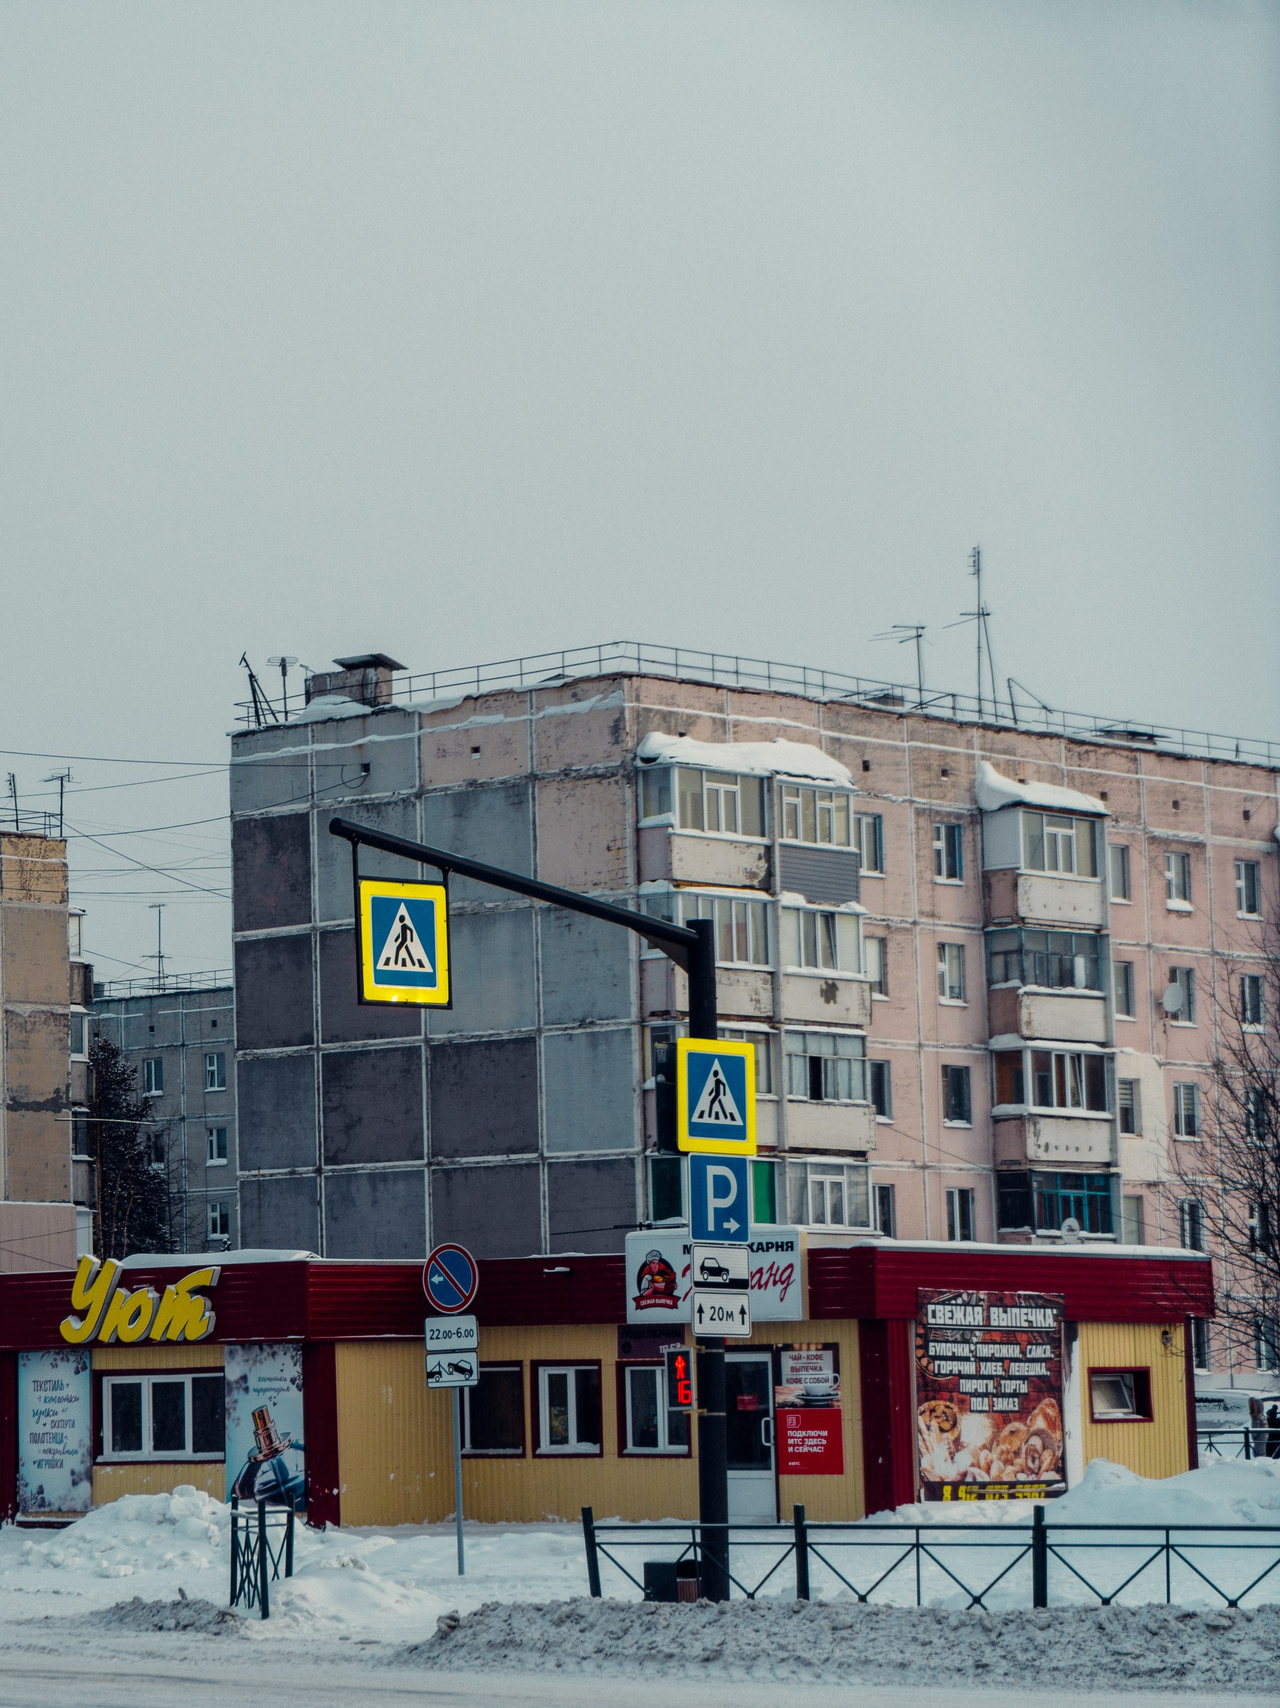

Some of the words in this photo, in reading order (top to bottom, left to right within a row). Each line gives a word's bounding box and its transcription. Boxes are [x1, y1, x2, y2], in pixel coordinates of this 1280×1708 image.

[60, 1254, 221, 1344] Уют
[927, 1304, 983, 1326] СВЕЖАЯ
[429, 1327, 475, 1340] 22.00-6.00
[789, 1353, 801, 1361] ЧАЙ
[806, 1353, 824, 1361] КОФЕ
[928, 1343, 974, 1358] БУЛОЧКИ,
[977, 1344, 1023, 1359] ПИРОЖКИ,
[1026, 1345, 1055, 1359] САМСА,
[790, 1365, 824, 1373] ВЫПЕЧКА
[979, 1362, 1005, 1376] ХЛЕБ,
[1008, 1362, 1051, 1376] ЛЕПЕШКА,
[32, 1379, 65, 1392] ТЕКСТИЛЬ
[785, 1377, 804, 1385] КОФЕ
[808, 1376, 830, 1384] СОБОЙ
[960, 1379, 997, 1394] ПИРОГИ,
[1000, 1380, 1028, 1393] ТОРТЫ
[677, 1380, 692, 1404] 16
[970, 1398, 989, 1412] ПОД
[992, 1398, 1019, 1411] ЗАКАЗ
[51, 1419, 76, 1429] СКАТЕРТИ
[29, 1432, 64, 1445] ПОЛОТЕНЦА
[787, 1430, 828, 1438] ПОДКЛЮЧИ
[804, 1438, 827, 1446] ЗДЕСЬ
[794, 1445, 825, 1453] СЕЙЧАС!
[36, 1459, 64, 1469] ИГРУШКИ
[942, 1485, 952, 1502] 8
